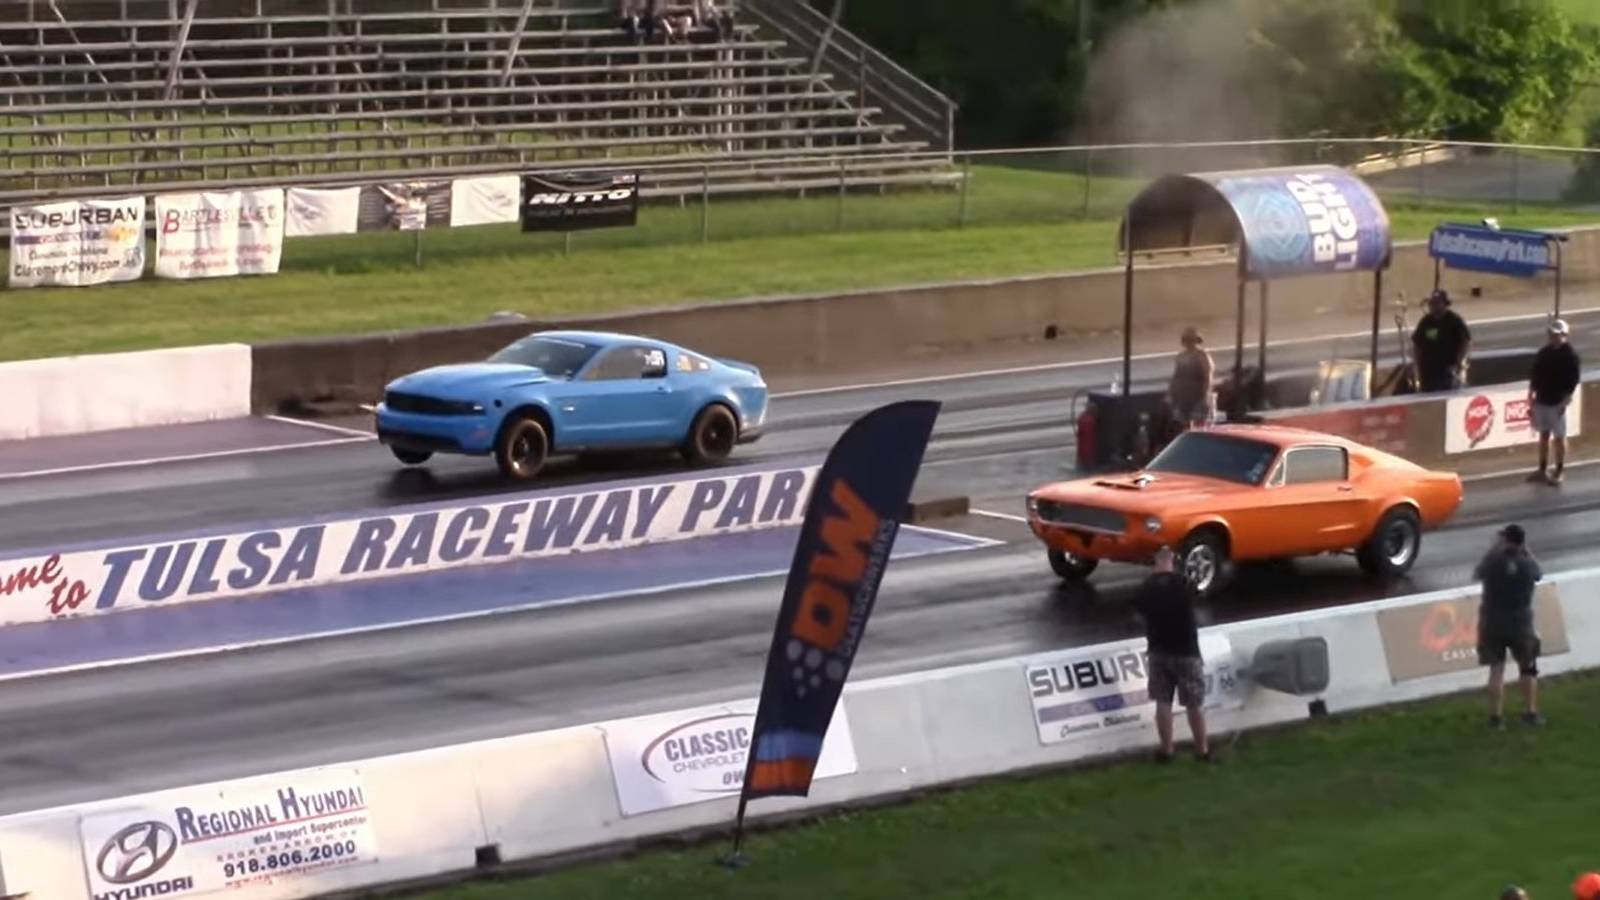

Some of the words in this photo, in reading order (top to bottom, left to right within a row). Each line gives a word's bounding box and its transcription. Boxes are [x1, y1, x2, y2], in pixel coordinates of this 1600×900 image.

[528, 188, 633, 205] NITTO
[15, 207, 138, 231] SUBURBAN
[1286, 180, 1337, 263] BUD
[1295, 173, 1359, 270] LIGHT
[96, 524, 326, 609] TULSA
[340, 484, 676, 575] RACEWAY
[680, 469, 808, 532] PAR
[790, 479, 879, 653] DW
[46, 575, 92, 614] to
[1029, 652, 1149, 698] SUBUR
[664, 727, 750, 761] CLASSIC
[673, 751, 746, 773] CHEVROLET
[175, 804, 277, 840] REGIONAL
[277, 786, 365, 820] HYUNDAI
[253, 831, 273, 846] and
[274, 826, 309, 842] Import
[310, 815, 367, 836] Supercenter
[223, 839, 357, 879] 918.806.2000
